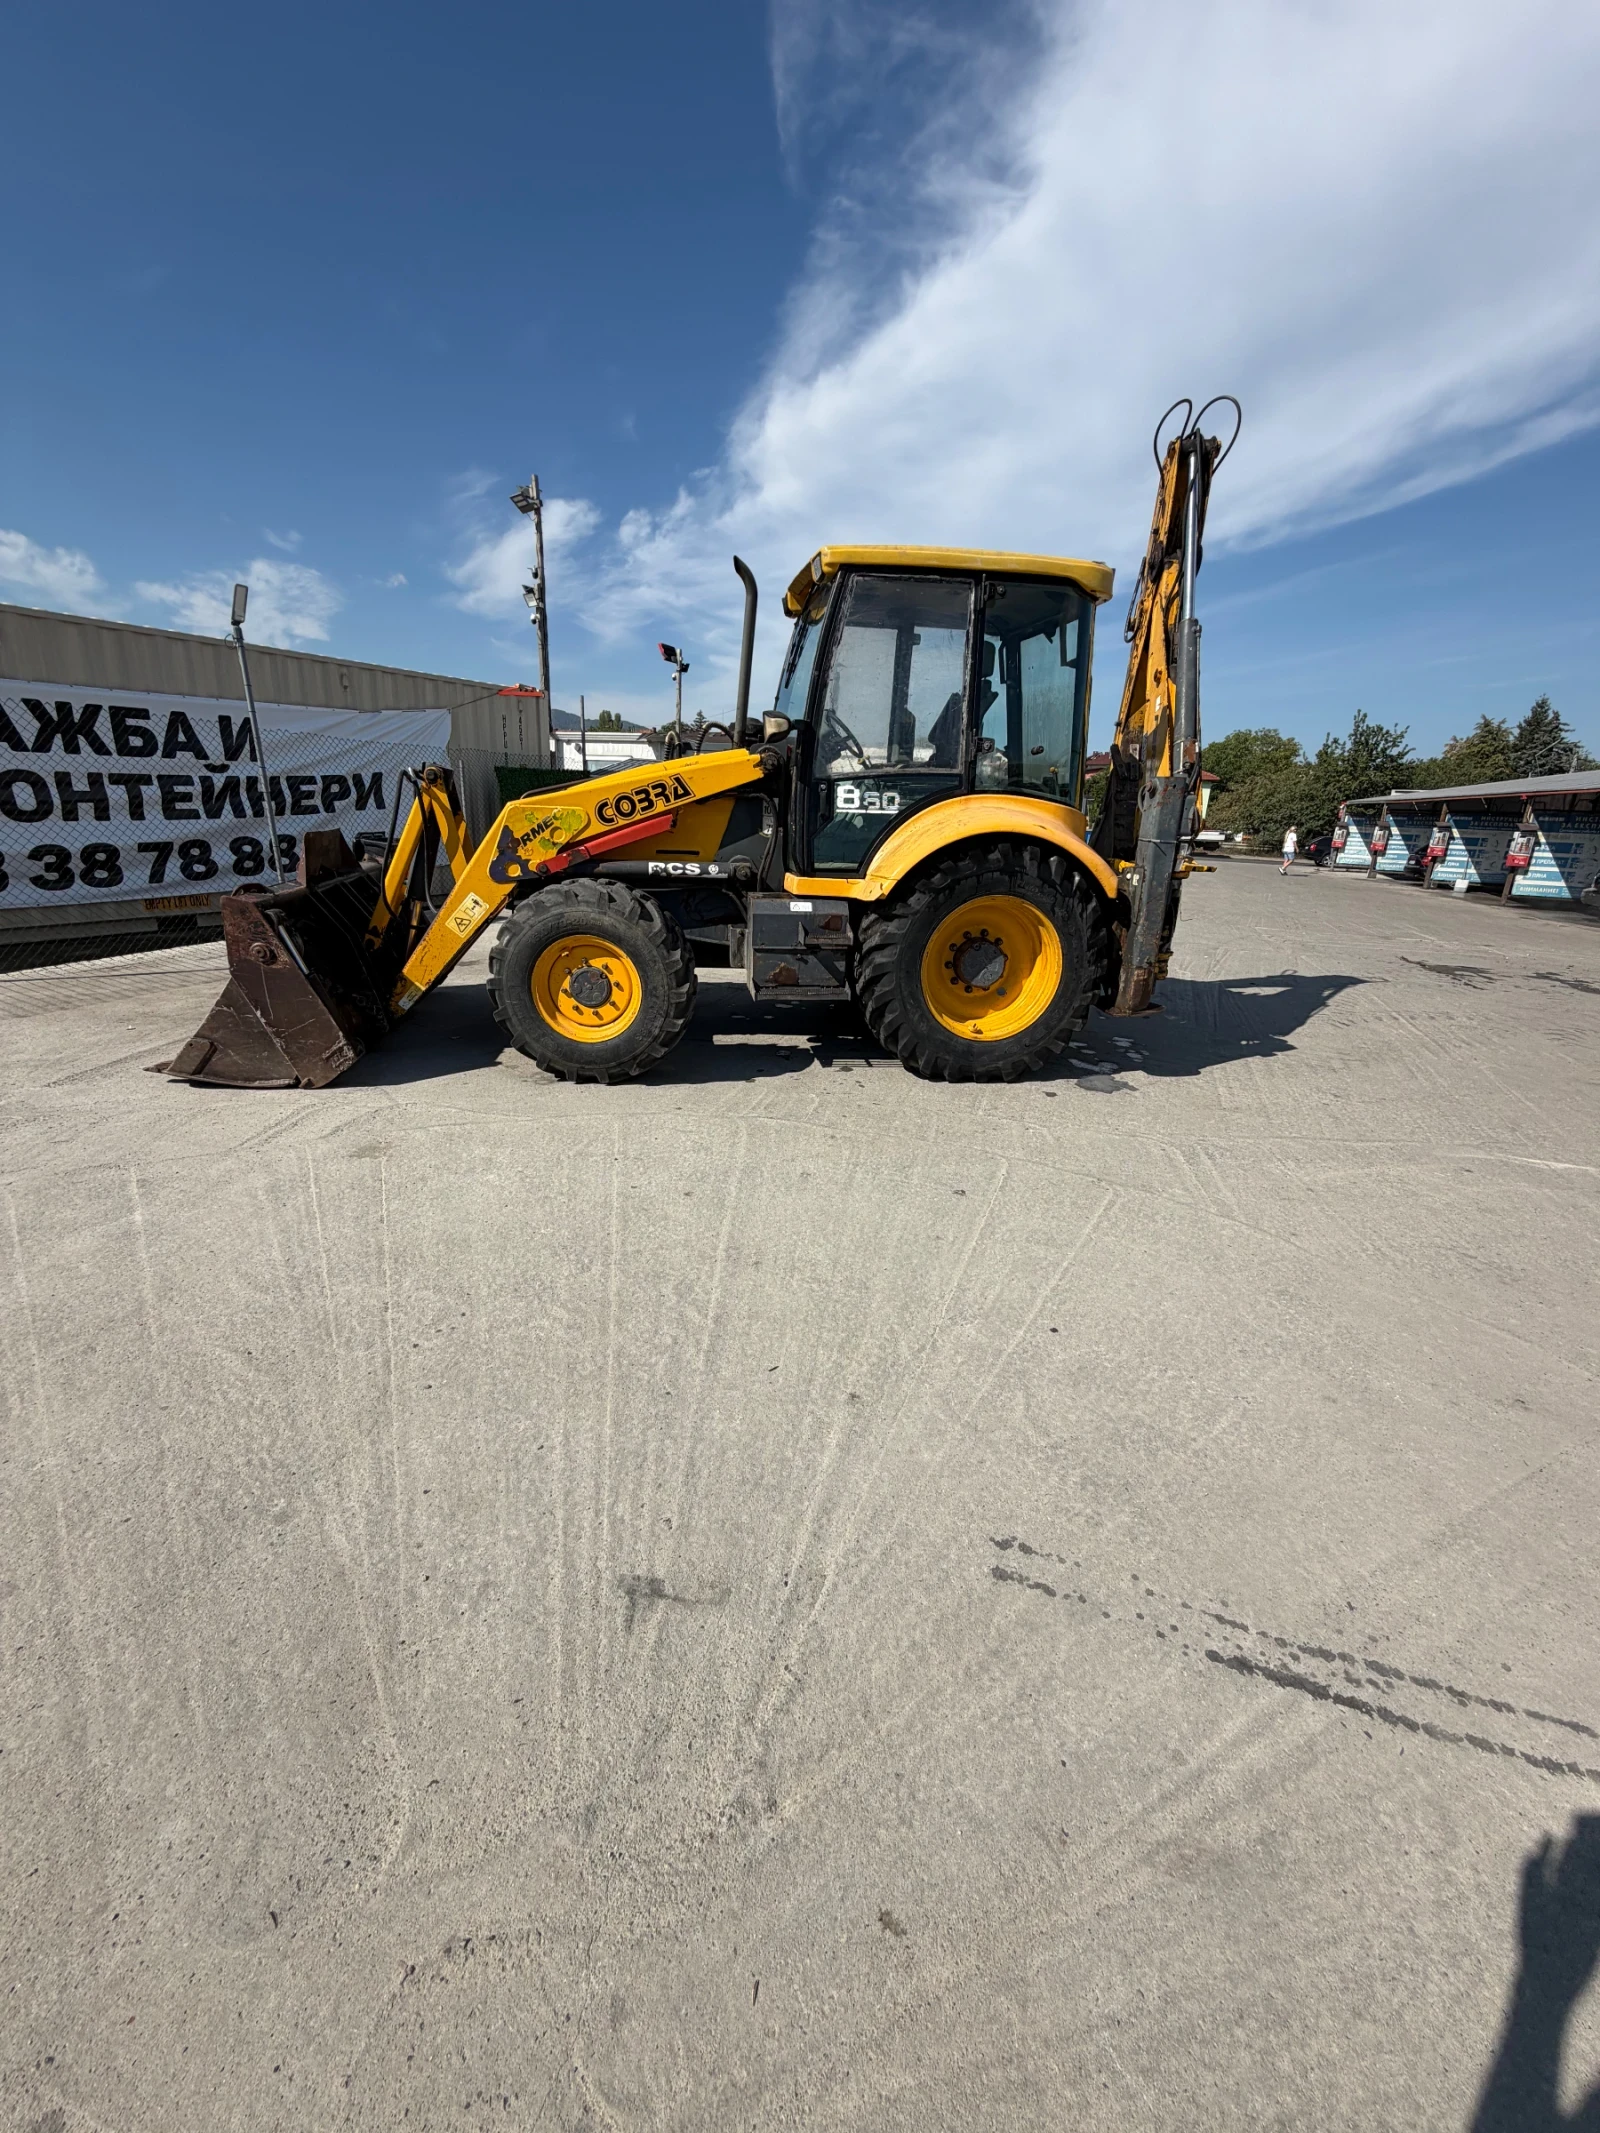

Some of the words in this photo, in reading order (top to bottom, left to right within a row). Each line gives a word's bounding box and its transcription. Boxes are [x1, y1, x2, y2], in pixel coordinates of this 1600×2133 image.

[595, 773, 696, 827] COBRA
[27, 843, 124, 891] 38
[138, 839, 219, 884] 78
